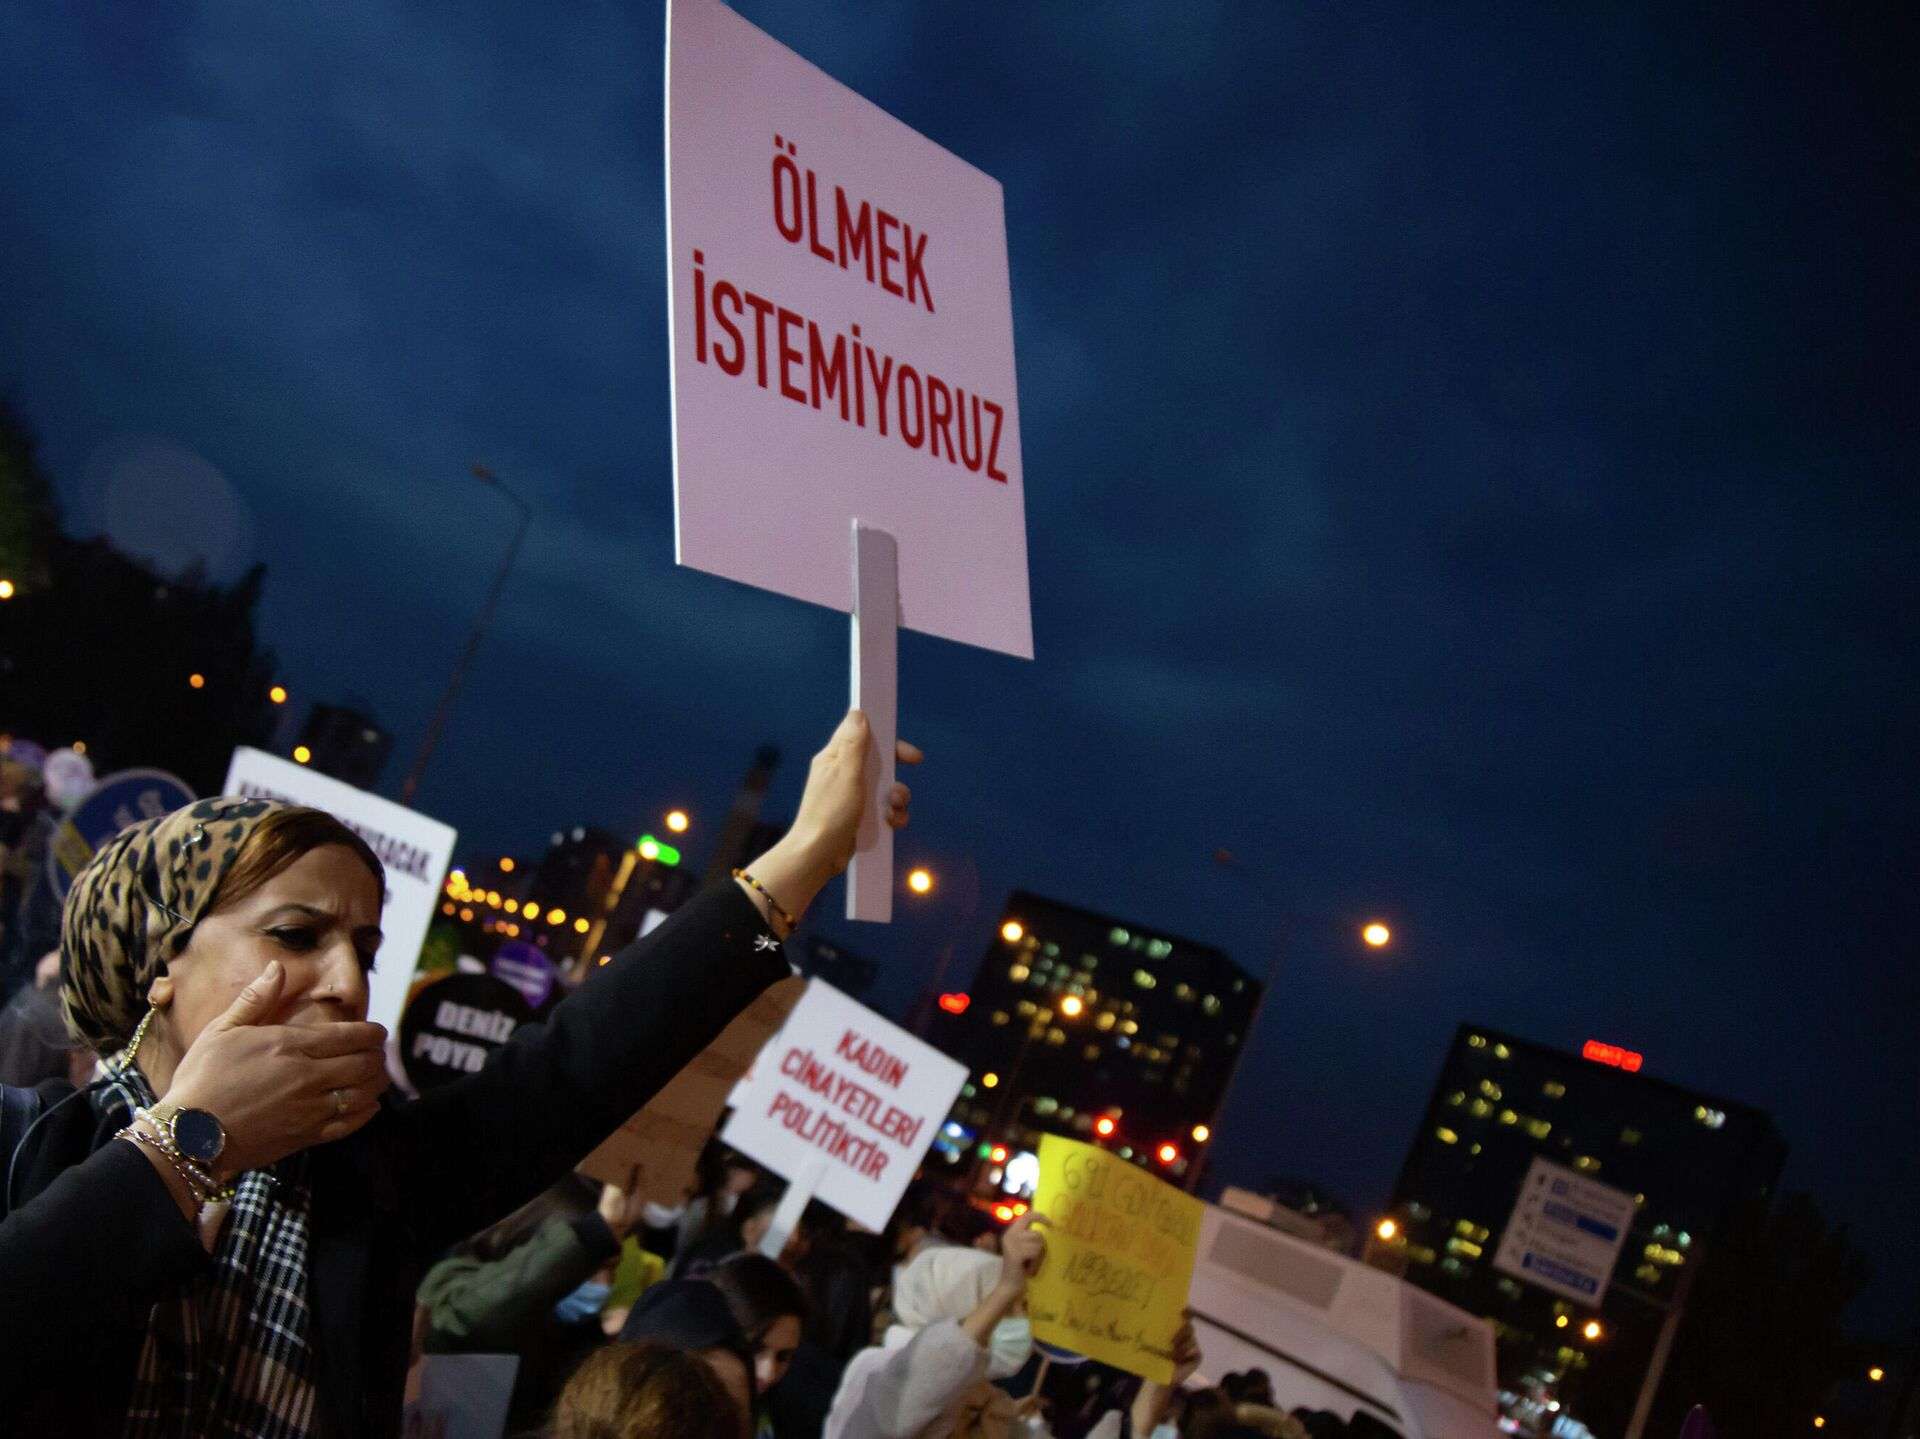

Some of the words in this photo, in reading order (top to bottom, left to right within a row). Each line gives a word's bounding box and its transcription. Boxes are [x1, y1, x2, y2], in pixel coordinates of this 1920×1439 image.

[772, 133, 936, 314] ÖLMEK
[693, 248, 1008, 485] İSTEMİYORUZ
[434, 1000, 517, 1044] DENİZ
[836, 1028, 909, 1089] KADIN
[767, 1091, 890, 1182] POLİTİKTİR
[780, 1046, 925, 1148] CİNAYETLERİ
